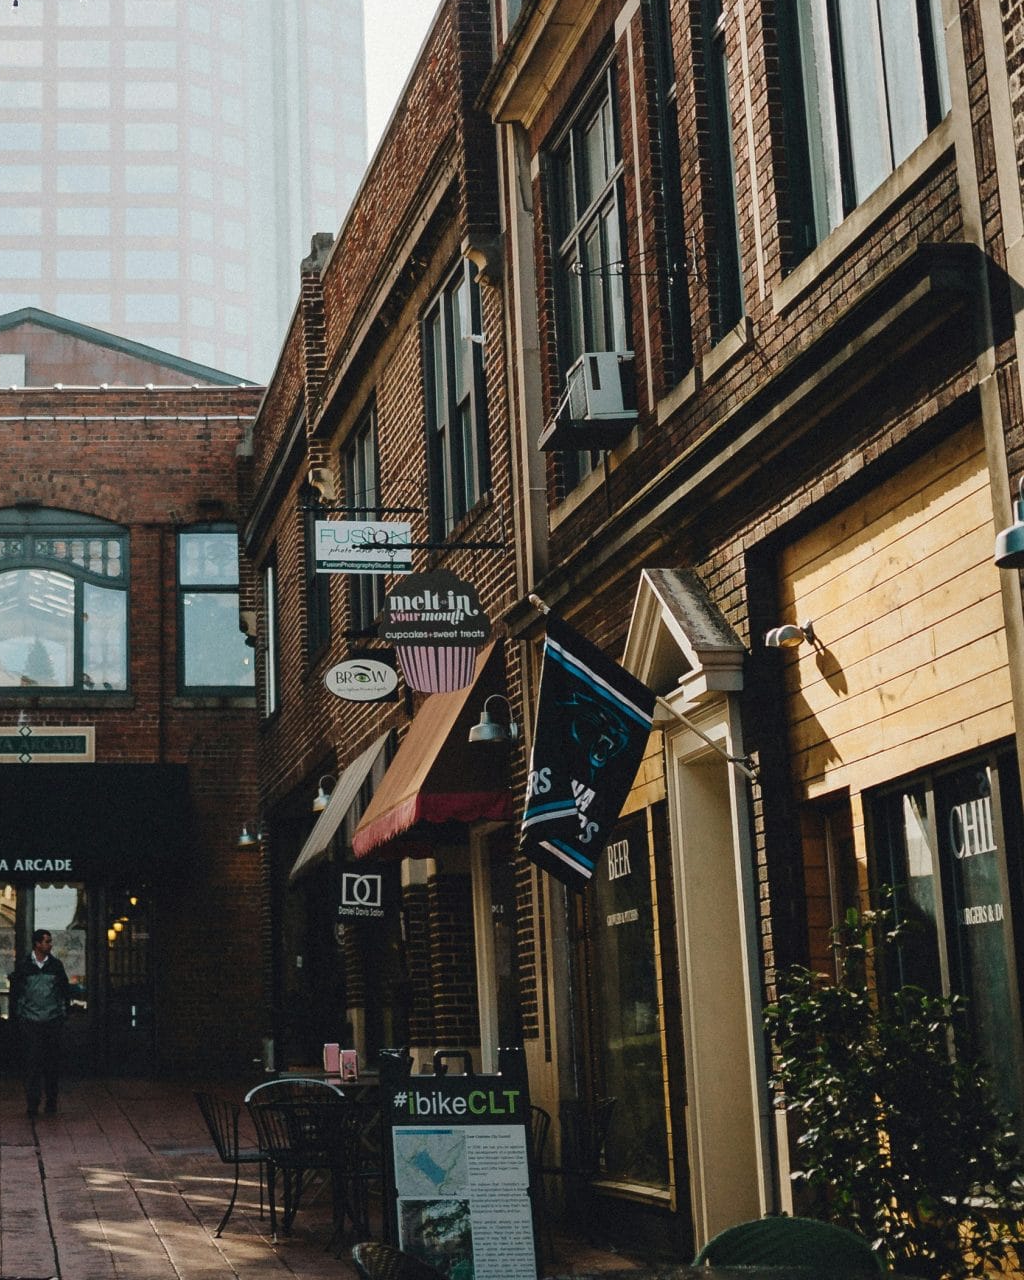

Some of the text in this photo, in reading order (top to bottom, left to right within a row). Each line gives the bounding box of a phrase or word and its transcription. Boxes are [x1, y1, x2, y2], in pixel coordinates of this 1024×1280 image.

[323, 561, 406, 570] FusionPhotographyStudiocom
[460, 629, 485, 638] treats
[14, 858, 73, 871] ARCADE
[607, 839, 631, 880] BEER
[393, 1090, 521, 1115] #ibikeCLT
